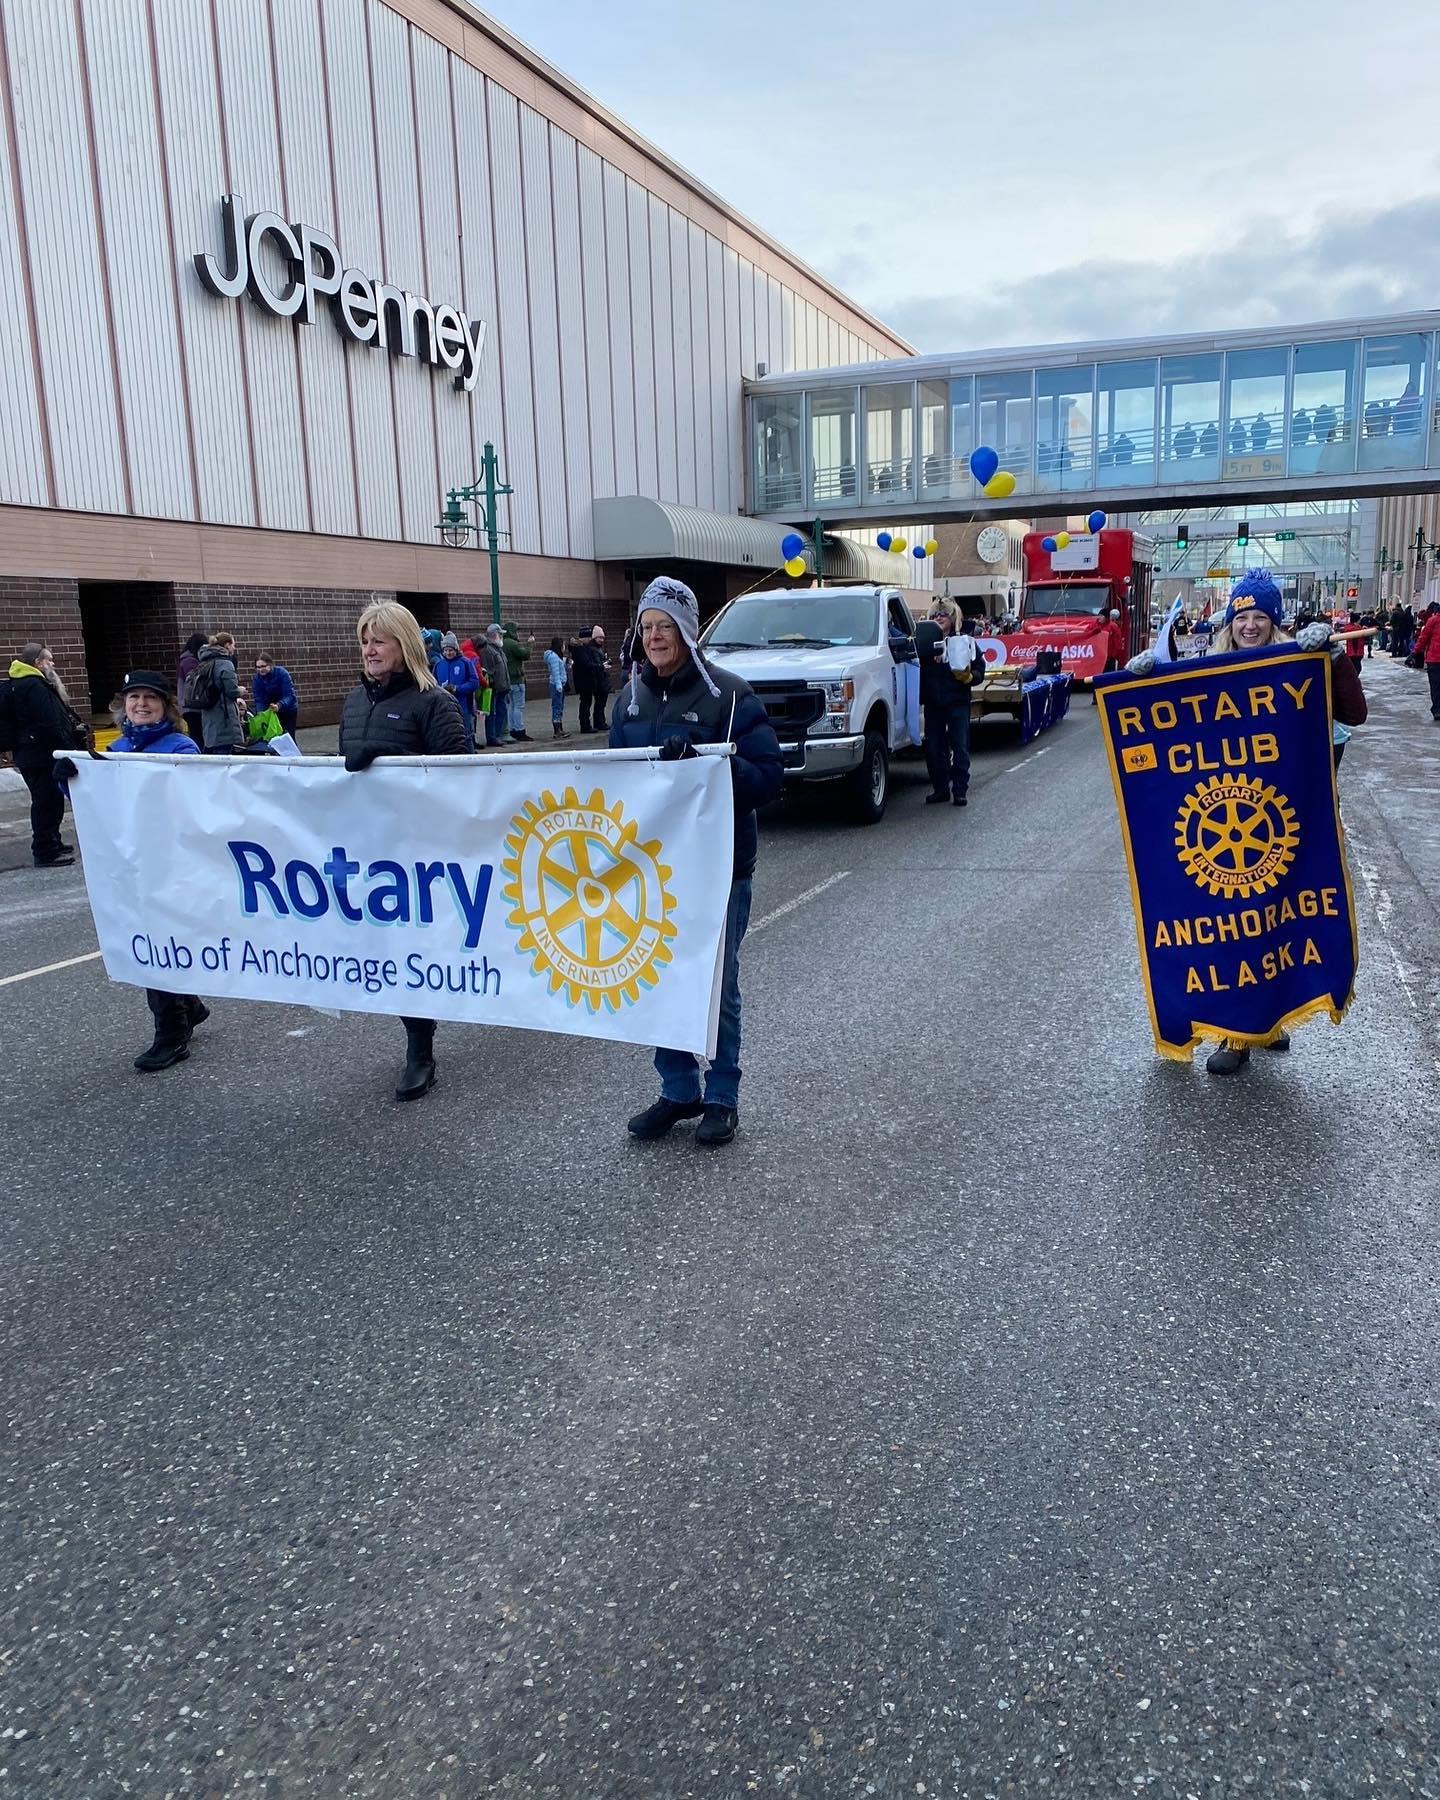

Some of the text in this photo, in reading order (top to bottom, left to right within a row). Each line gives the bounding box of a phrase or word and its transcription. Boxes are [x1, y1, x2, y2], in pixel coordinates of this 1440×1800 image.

[193, 193, 487, 392] JCPenney
[1118, 678, 1313, 736] ROTARY
[1168, 733, 1280, 774] CLUB
[542, 810, 615, 835] ROTARY
[1202, 786, 1262, 808] ROTARY
[1194, 846, 1284, 885] INTERNATIONAL
[227, 840, 494, 950] Rotary
[1154, 887, 1339, 948] ANCHORAGE
[131, 934, 502, 996] Club of Anchorage South
[535, 926, 656, 986] INTERNATIONAL
[1186, 938, 1322, 993] ALASKA
